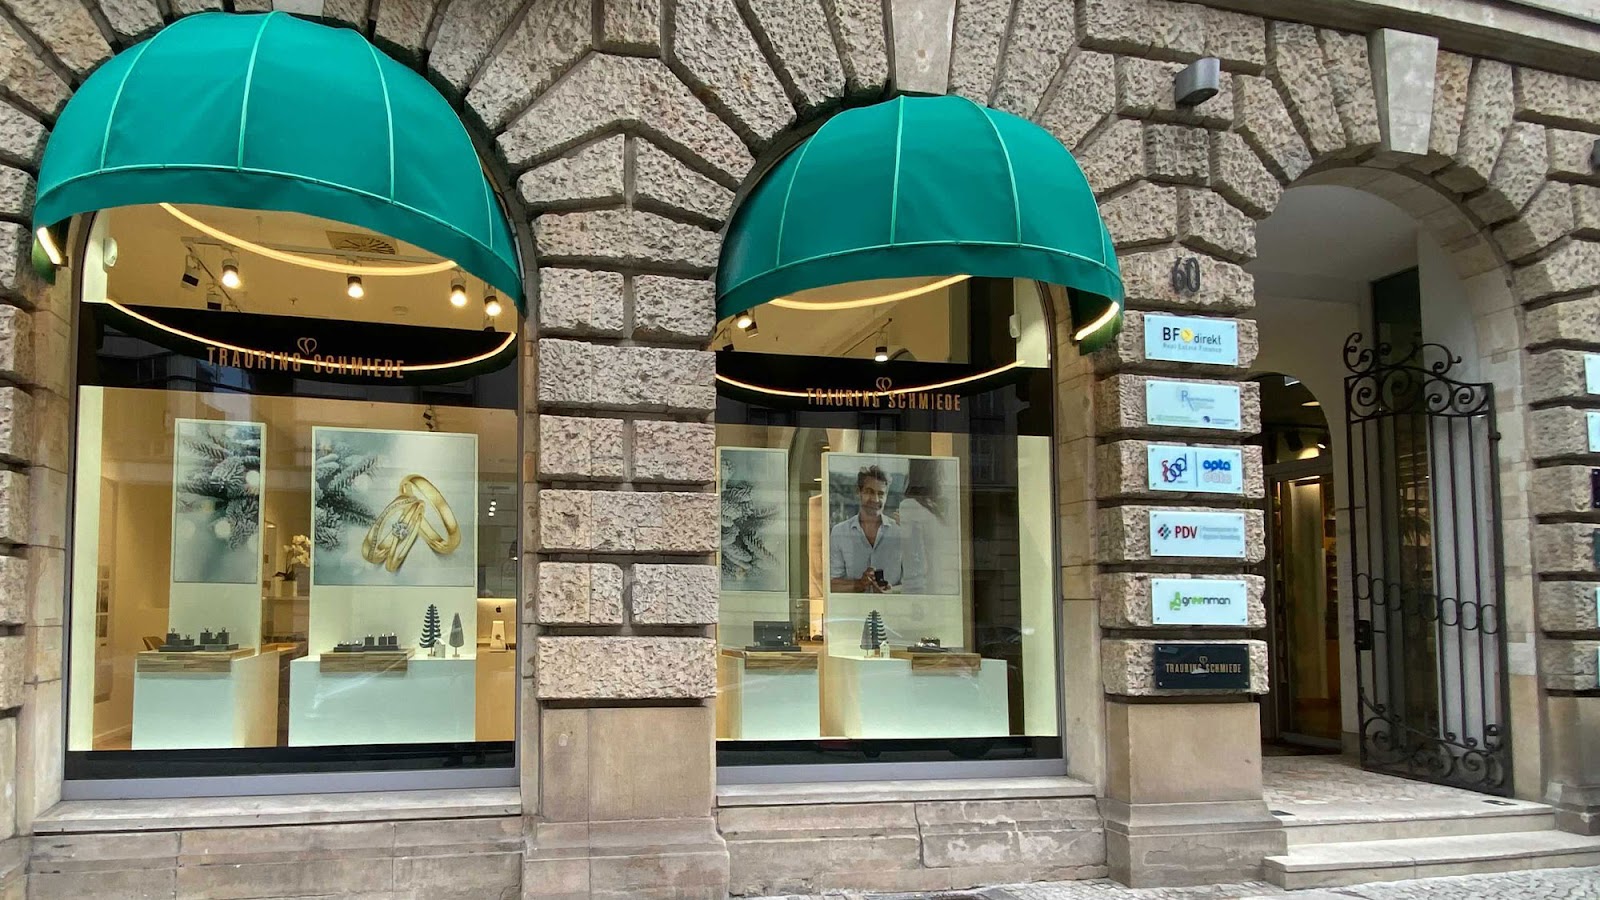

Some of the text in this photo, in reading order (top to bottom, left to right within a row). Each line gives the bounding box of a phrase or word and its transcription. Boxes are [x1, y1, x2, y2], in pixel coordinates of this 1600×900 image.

[1171, 256, 1200, 292] 60
[1194, 333, 1222, 345] direkt
[206, 346, 405, 379] TRAURING SCHMIEDE
[806, 387, 961, 412] TRAURING SCHMIEDE
[1203, 459, 1231, 471] opta
[1174, 525, 1198, 539] PDV
[1181, 596, 1231, 607] greenman
[1205, 663, 1241, 673] SCHMIEDE
